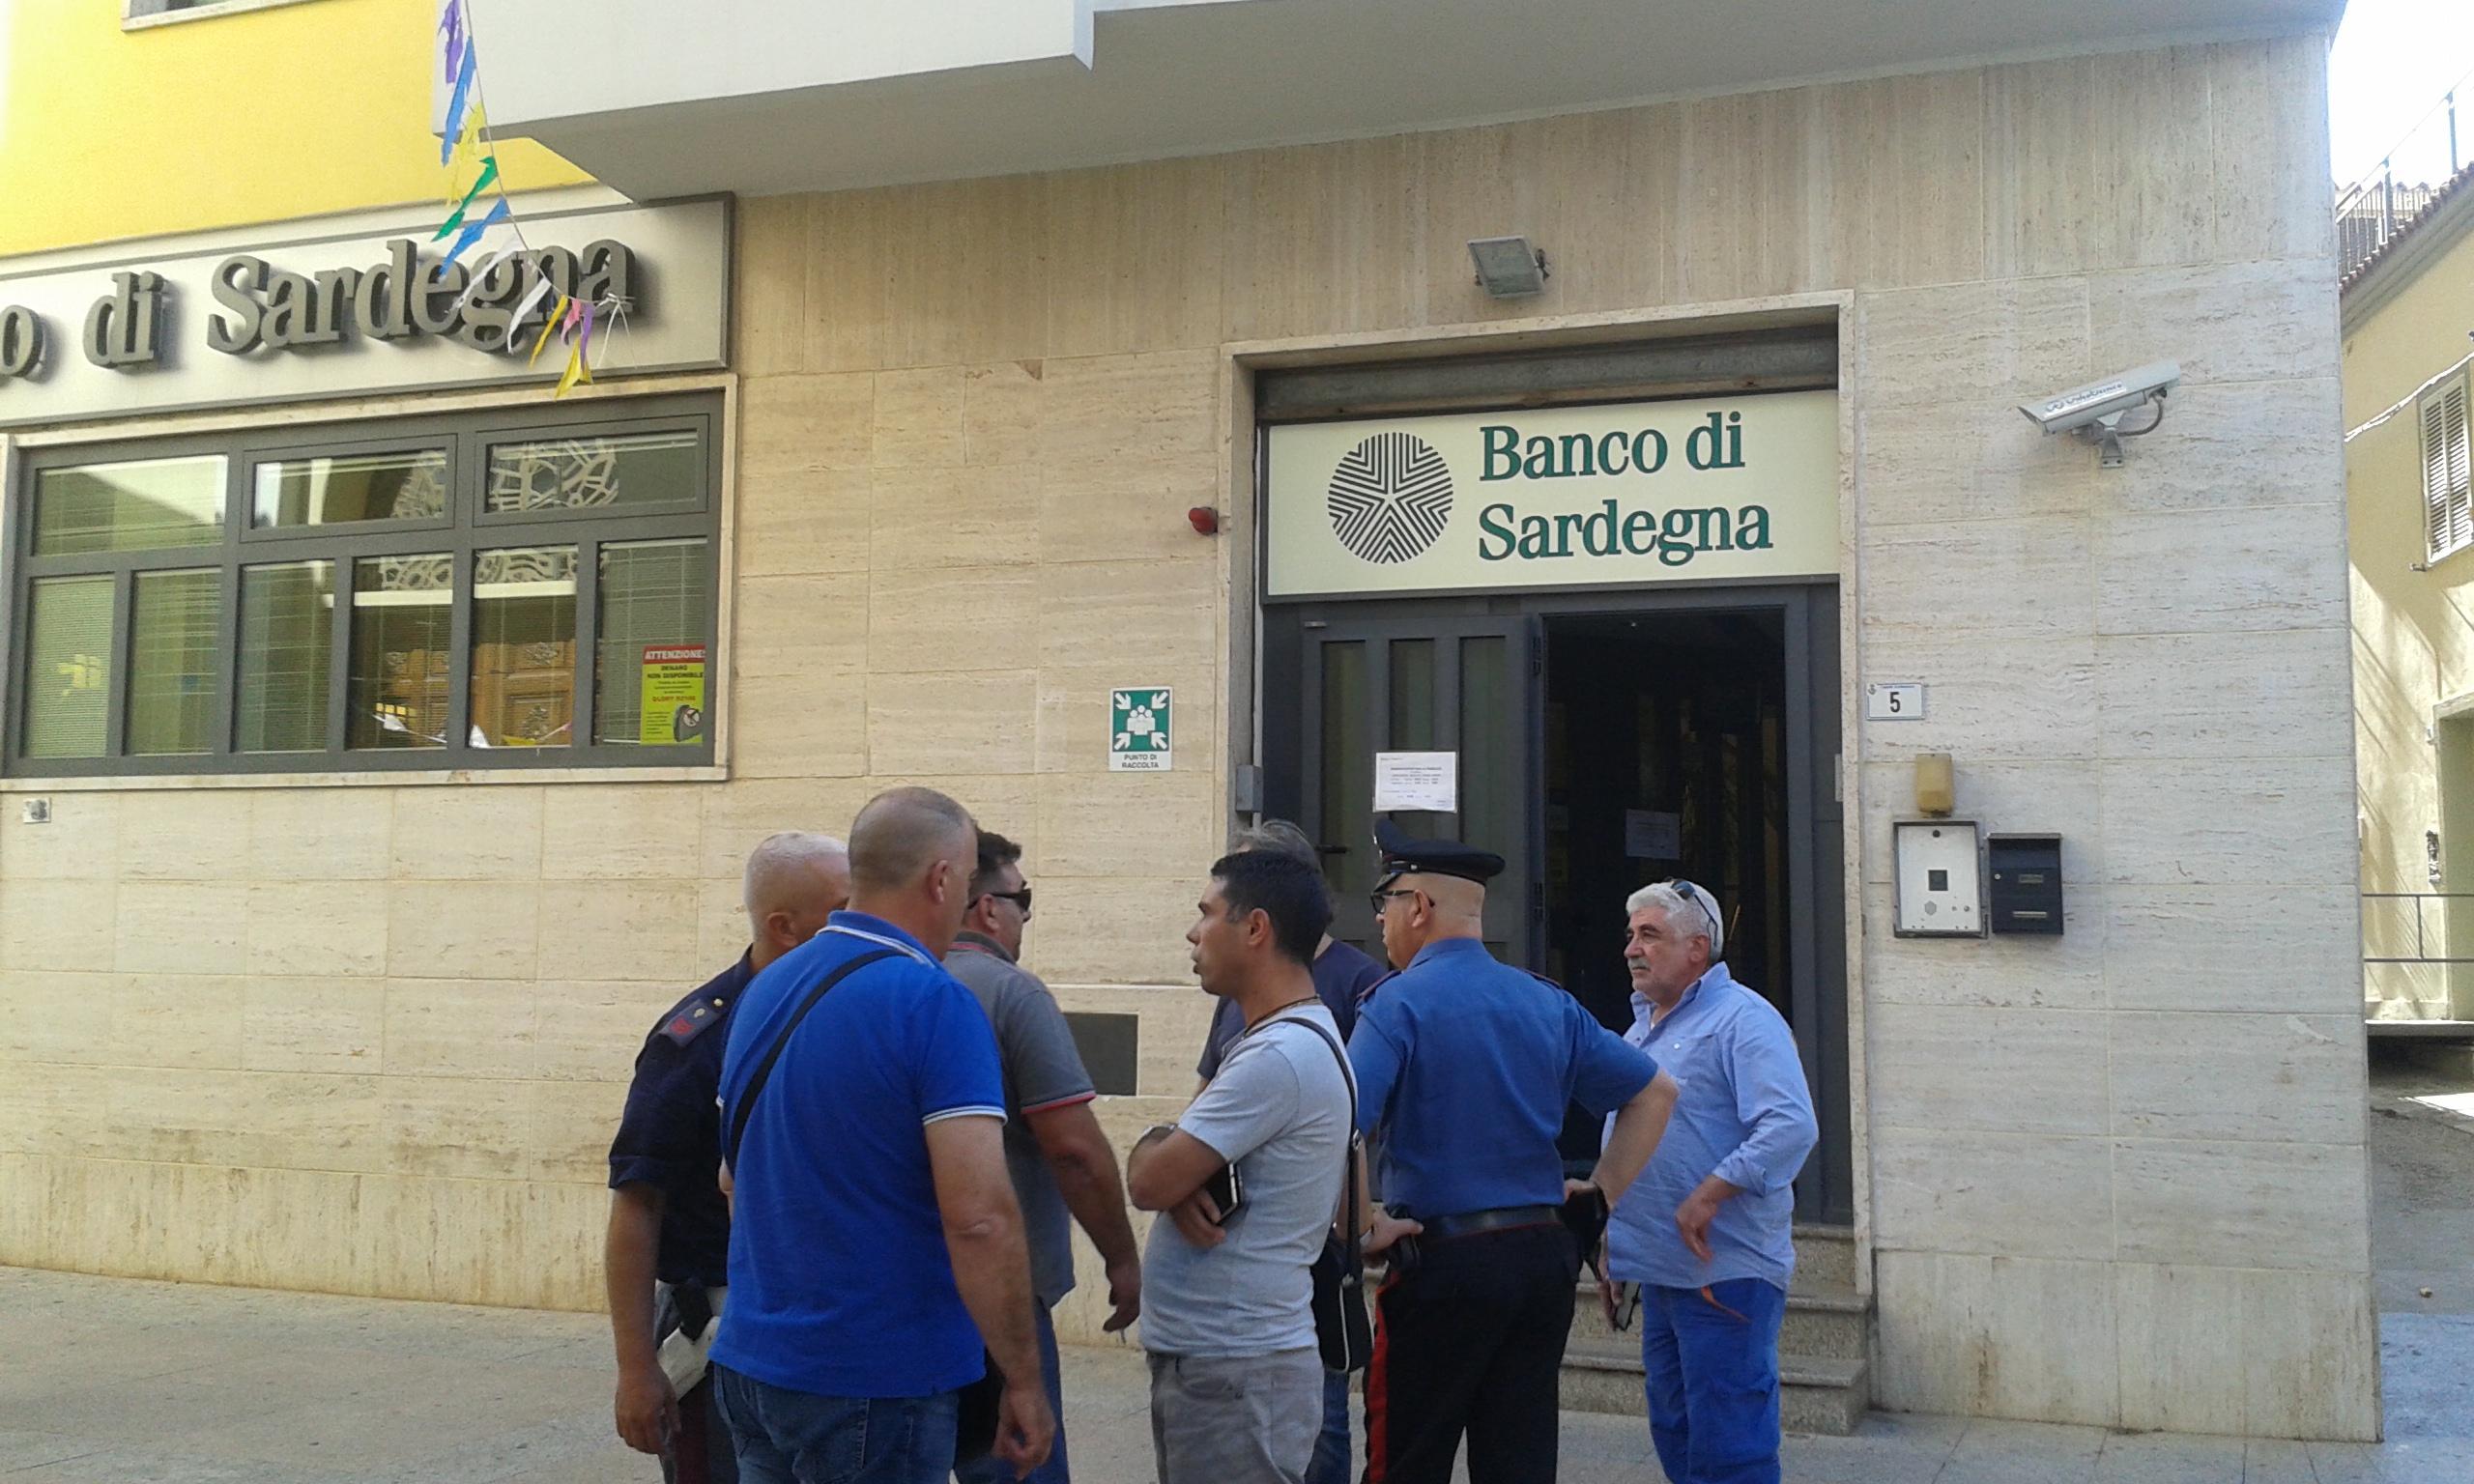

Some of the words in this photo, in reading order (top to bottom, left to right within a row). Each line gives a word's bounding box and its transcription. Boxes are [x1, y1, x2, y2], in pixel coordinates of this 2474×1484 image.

[0, 304, 43, 377] o
[83, 271, 164, 368] di
[207, 238, 636, 354] Sardegna
[1480, 425, 1668, 481] Banco
[1685, 411, 1745, 471] di
[1479, 499, 1773, 566] Sardegna
[1889, 691, 1901, 713] 5
